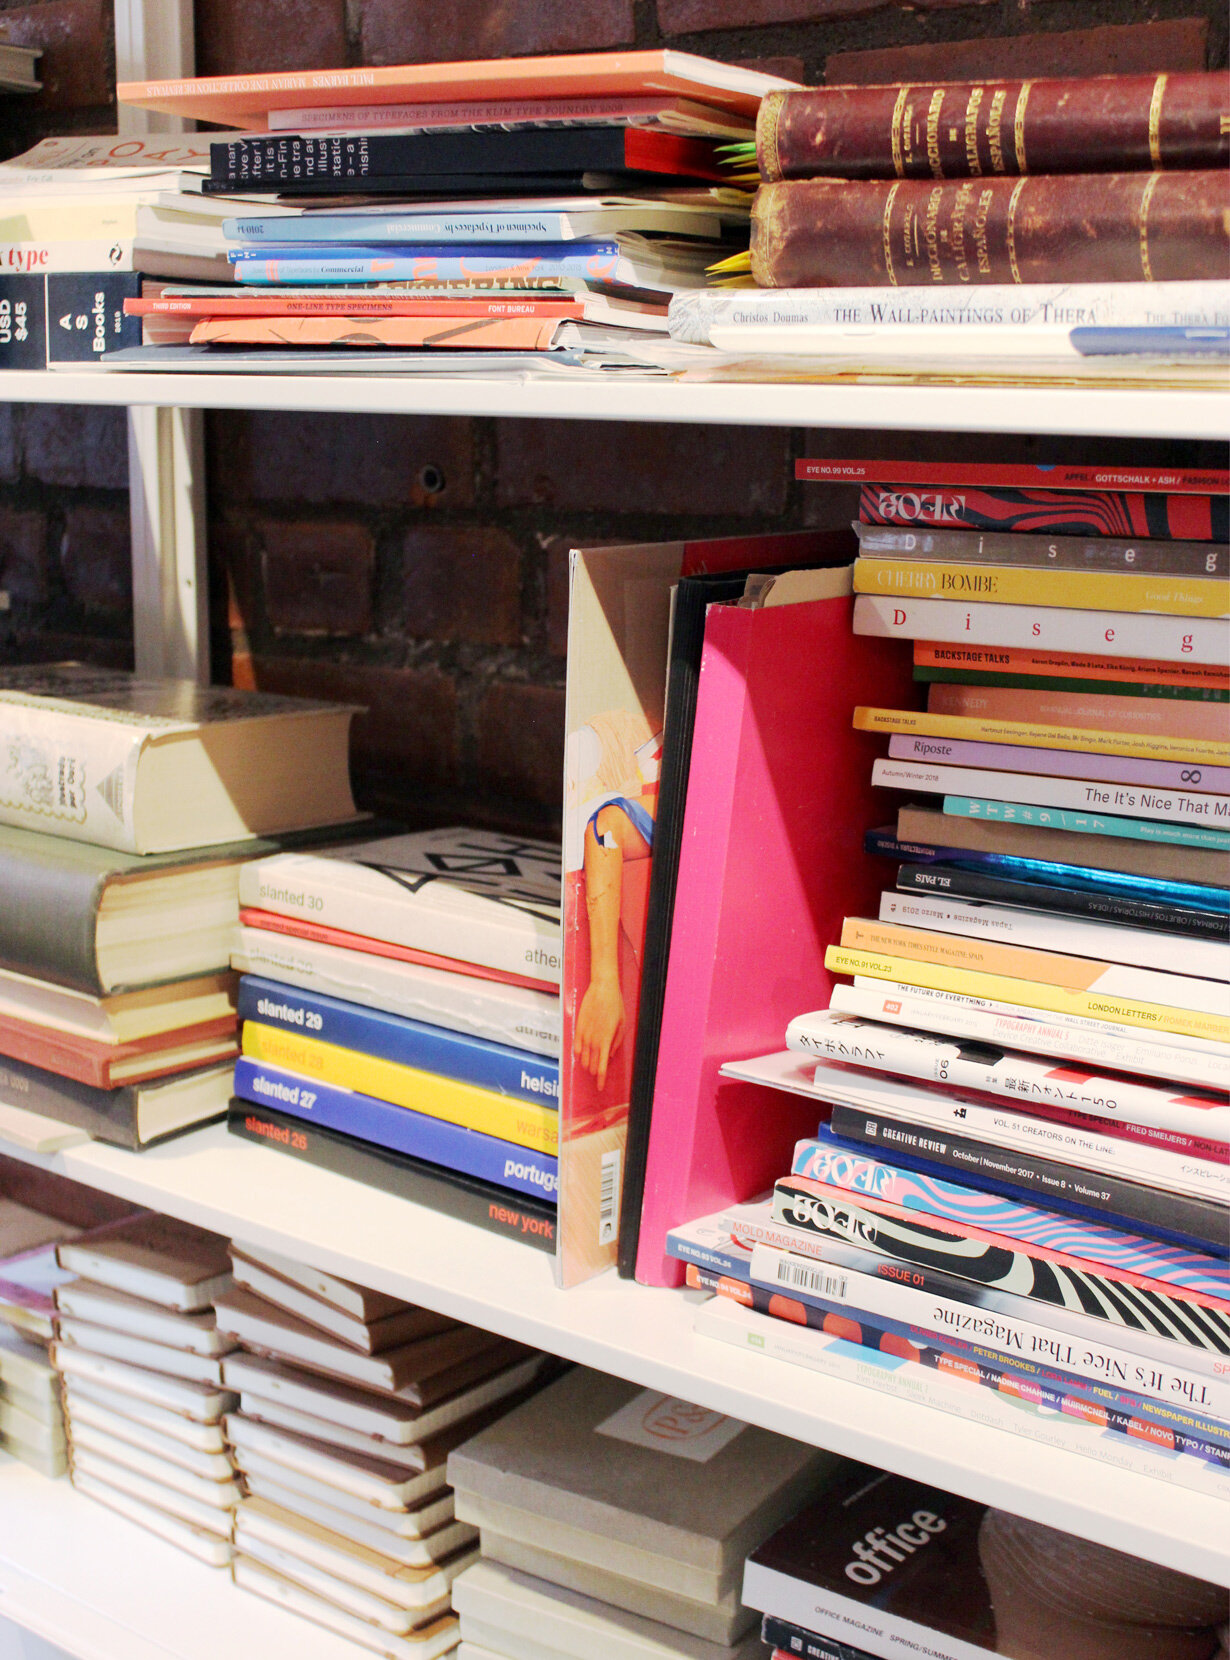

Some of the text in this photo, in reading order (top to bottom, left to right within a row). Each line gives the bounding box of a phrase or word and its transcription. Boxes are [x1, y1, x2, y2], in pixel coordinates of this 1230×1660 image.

[312, 74, 350, 88] BARNES
[301, 111, 356, 123] SPECIMENS
[356, 110, 371, 121] OF
[372, 110, 426, 121] TYPEFACES
[430, 109, 459, 119] FROM
[461, 108, 482, 118] THE
[514, 106, 542, 116] TYPE
[544, 105, 596, 116] FOUNDRY
[964, 87, 984, 176] CALIGRAFOS
[985, 89, 1008, 172] ESPAÑOLES
[265, 147, 275, 173] it is
[386, 221, 548, 234] Specimen Typefaces Commercial
[972, 189, 994, 274] ESPAÑOLES
[8, 247, 49, 273] type
[321, 265, 365, 274] Commercial
[485, 263, 509, 273] London
[152, 302, 192, 310] THIRD EDITION
[286, 303, 393, 311] ONE-LINE TYPE SPECIMENS
[488, 304, 535, 314] FONT BUREAU
[733, 310, 809, 324] Christos Doumas
[833, 307, 862, 323] THE
[1010, 306, 1031, 324] OF
[1039, 302, 1098, 324] THERA
[0, 299, 12, 344] USD
[14, 301, 29, 342] $45
[59, 313, 72, 331] A
[91, 291, 106, 353] Books
[806, 465, 866, 476] EYE VOL.25
[1095, 473, 1176, 485] GOTTSCHALK ASH
[876, 569, 999, 593] CHERRY BOMBE
[1145, 590, 1204, 604] Good Things
[934, 649, 1011, 665] BACKSTAGE TALKS
[873, 715, 917, 726] BACKSTAGE TALKS
[913, 740, 953, 757] Riposte
[1098, 736, 1113, 744] Mark
[881, 768, 940, 782] Autumn/Winter 2018
[1084, 787, 1210, 815] The It's Nice That
[1140, 825, 1216, 842] Play much more than
[937, 877, 952, 888] EL
[258, 883, 325, 912] slanted 30
[901, 906, 1013, 931] Tapas Magazine Marzo 2019
[1088, 902, 1224, 932] FORMAS OBJETOS HISTORIAS IDEAS
[869, 935, 938, 954] THE NEW YORK TIMES STYLE
[835, 955, 893, 973] EYE VOL.23
[897, 984, 987, 1008] THE FUTURE OF EVERYTHING
[256, 997, 324, 1031] slanted 29
[1064, 1016, 1101, 1029] WALL STREET
[1087, 1001, 1122, 1016] LONDON
[1121, 1007, 1158, 1022] LETTERS
[1163, 1015, 1193, 1029] ROMEK
[995, 1017, 1038, 1036] TYPOGRAPHY
[1037, 1025, 1065, 1040] ANNUAL
[260, 1037, 325, 1072] slanted 28
[1019, 1032, 1054, 1049] Creative
[1053, 1038, 1107, 1058] Collaborative
[1115, 1052, 1145, 1066] Exhibit
[252, 1075, 318, 1110] slanted 27
[245, 1116, 308, 1152] slanted 26
[993, 1117, 1096, 1150] VOL. 51 CREATORS ON THE
[1088, 1113, 1188, 1146] SPECIAL FRED SMEIJERS
[882, 1127, 1112, 1201] CREATIVE REVIEW October November 2017 Issue 8 Volume 37
[488, 1202, 555, 1239] new york
[677, 1243, 691, 1255] EYE
[731, 1221, 824, 1258] MOLD MAGAZINE
[696, 1274, 711, 1287] EYE
[877, 1263, 925, 1287] ISSUE 01
[932, 1306, 1213, 1407] The It's Nice That Magazine
[973, 1346, 1195, 1427] PETER BROOKES FUEL NEWSPAPER
[933, 1354, 1199, 1450] TYPE SPECIAL NADINE CHAHINE MUIRMCNEIL KABEL NOVO TYPO
[844, 1509, 948, 1586] office
[814, 1605, 885, 1638] OFFICE MAGAZINE
